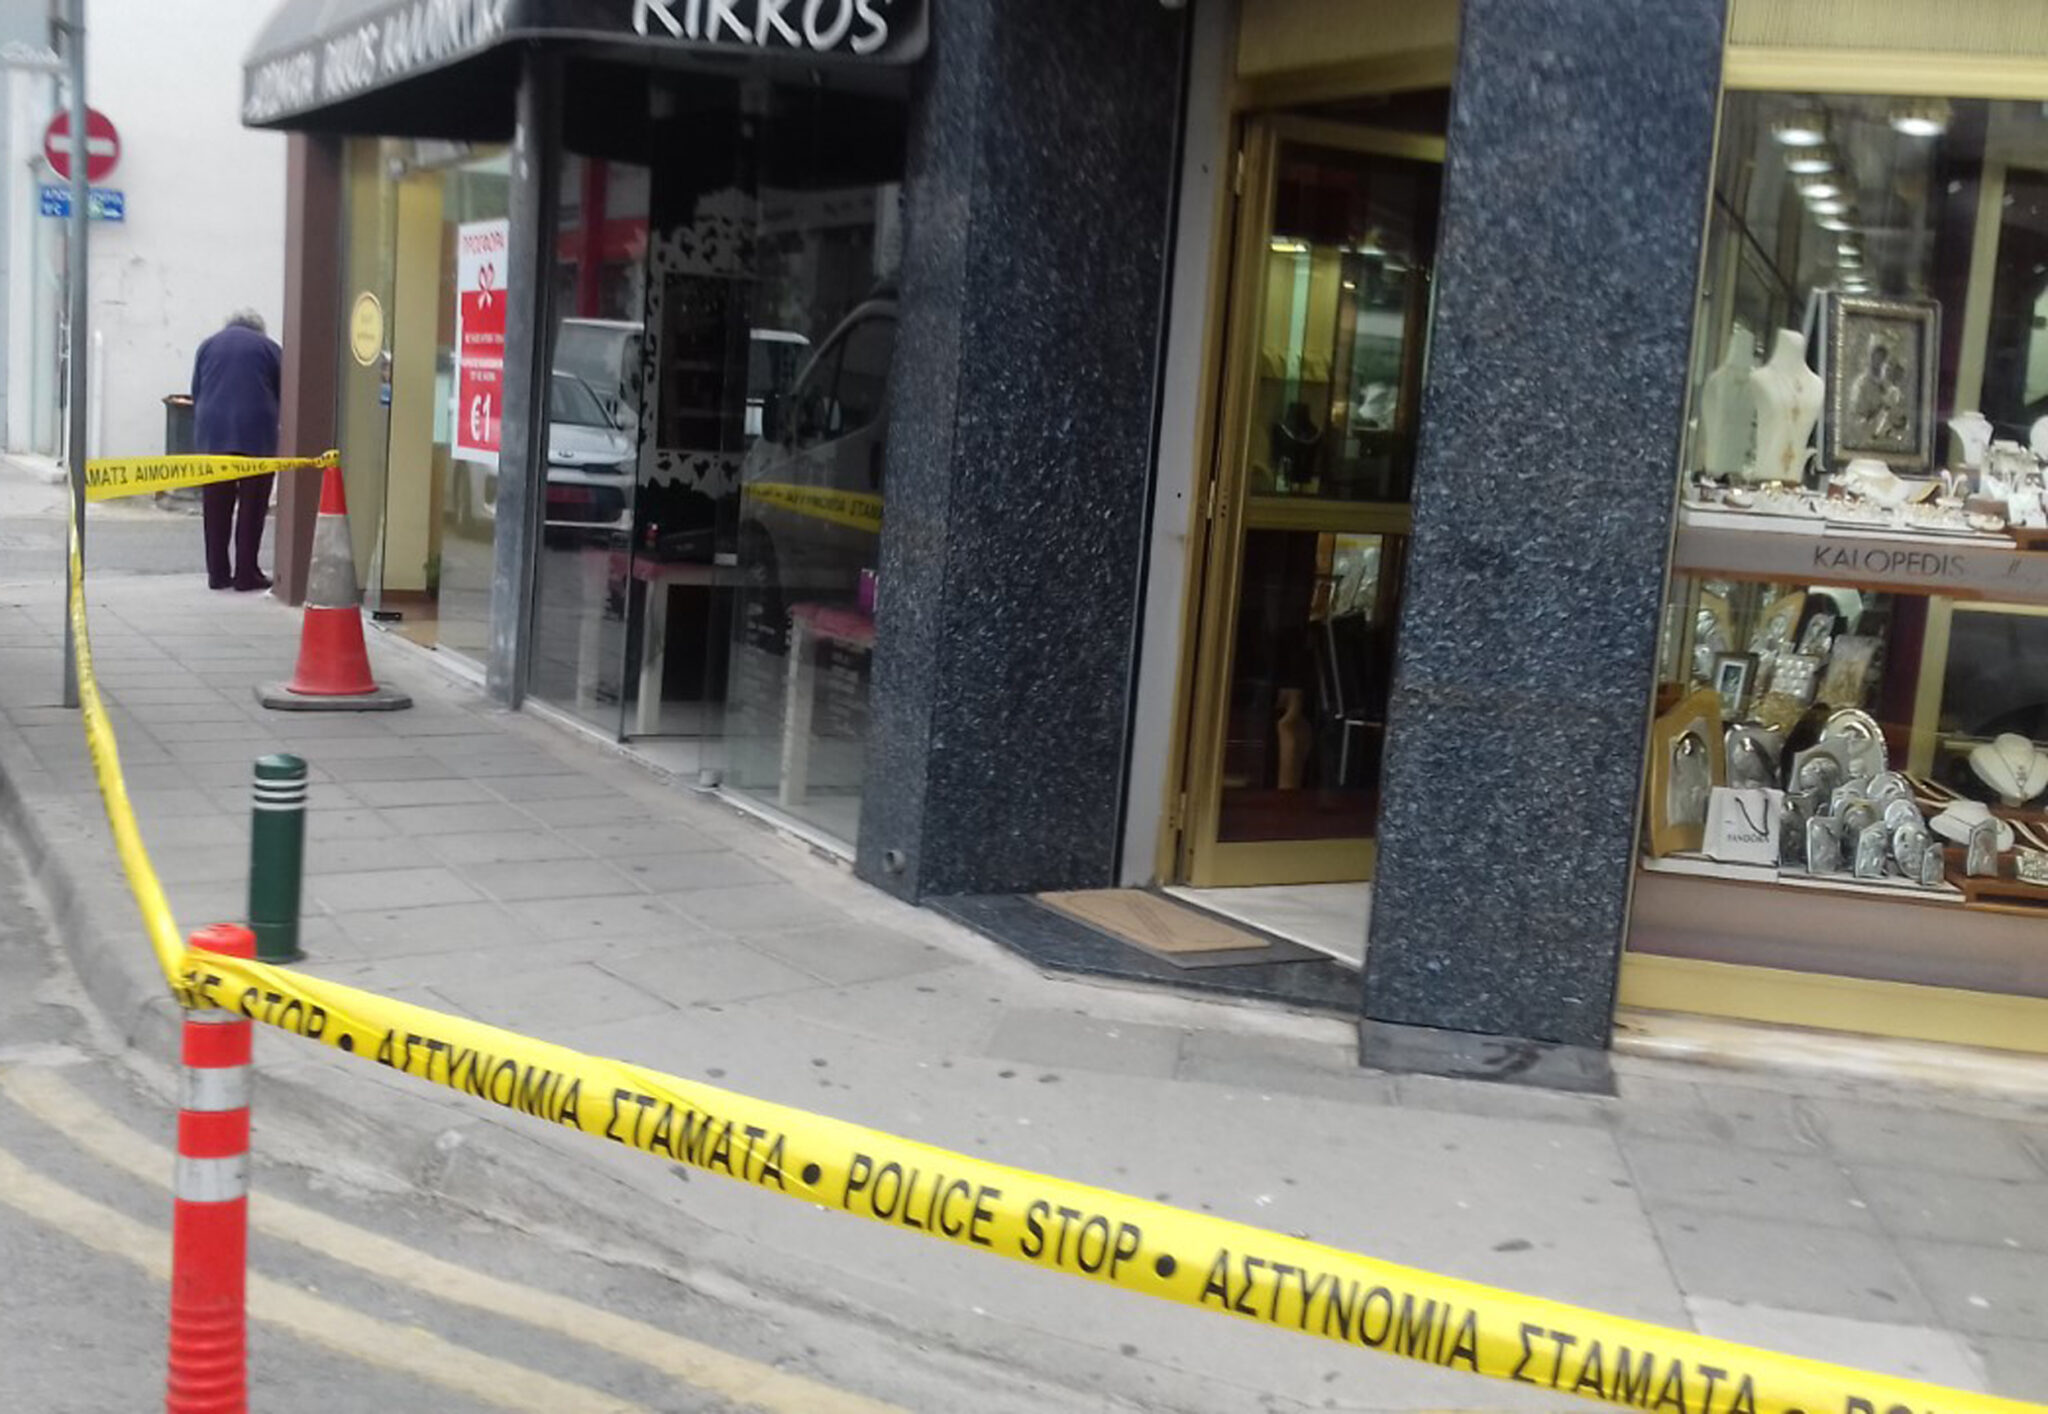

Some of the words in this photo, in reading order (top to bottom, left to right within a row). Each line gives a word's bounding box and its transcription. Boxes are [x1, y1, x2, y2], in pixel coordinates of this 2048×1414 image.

[470, 392, 491, 443] €1
[1812, 545, 1966, 578] KALOPEDIS
[239, 986, 328, 1041] STOP
[377, 1028, 584, 1132] ΑΣΤΥΝΟΜΙΑ
[605, 1087, 788, 1191] ΣΤΑΜΑΤΑ
[843, 1152, 1003, 1247] POLICE
[1019, 1199, 1142, 1279] STOP
[1199, 1248, 1481, 1373] ΑΣΤΥΝΟΜΙΑ
[1512, 1321, 1757, 1414] ΣΤΑΜΑΤΑ
